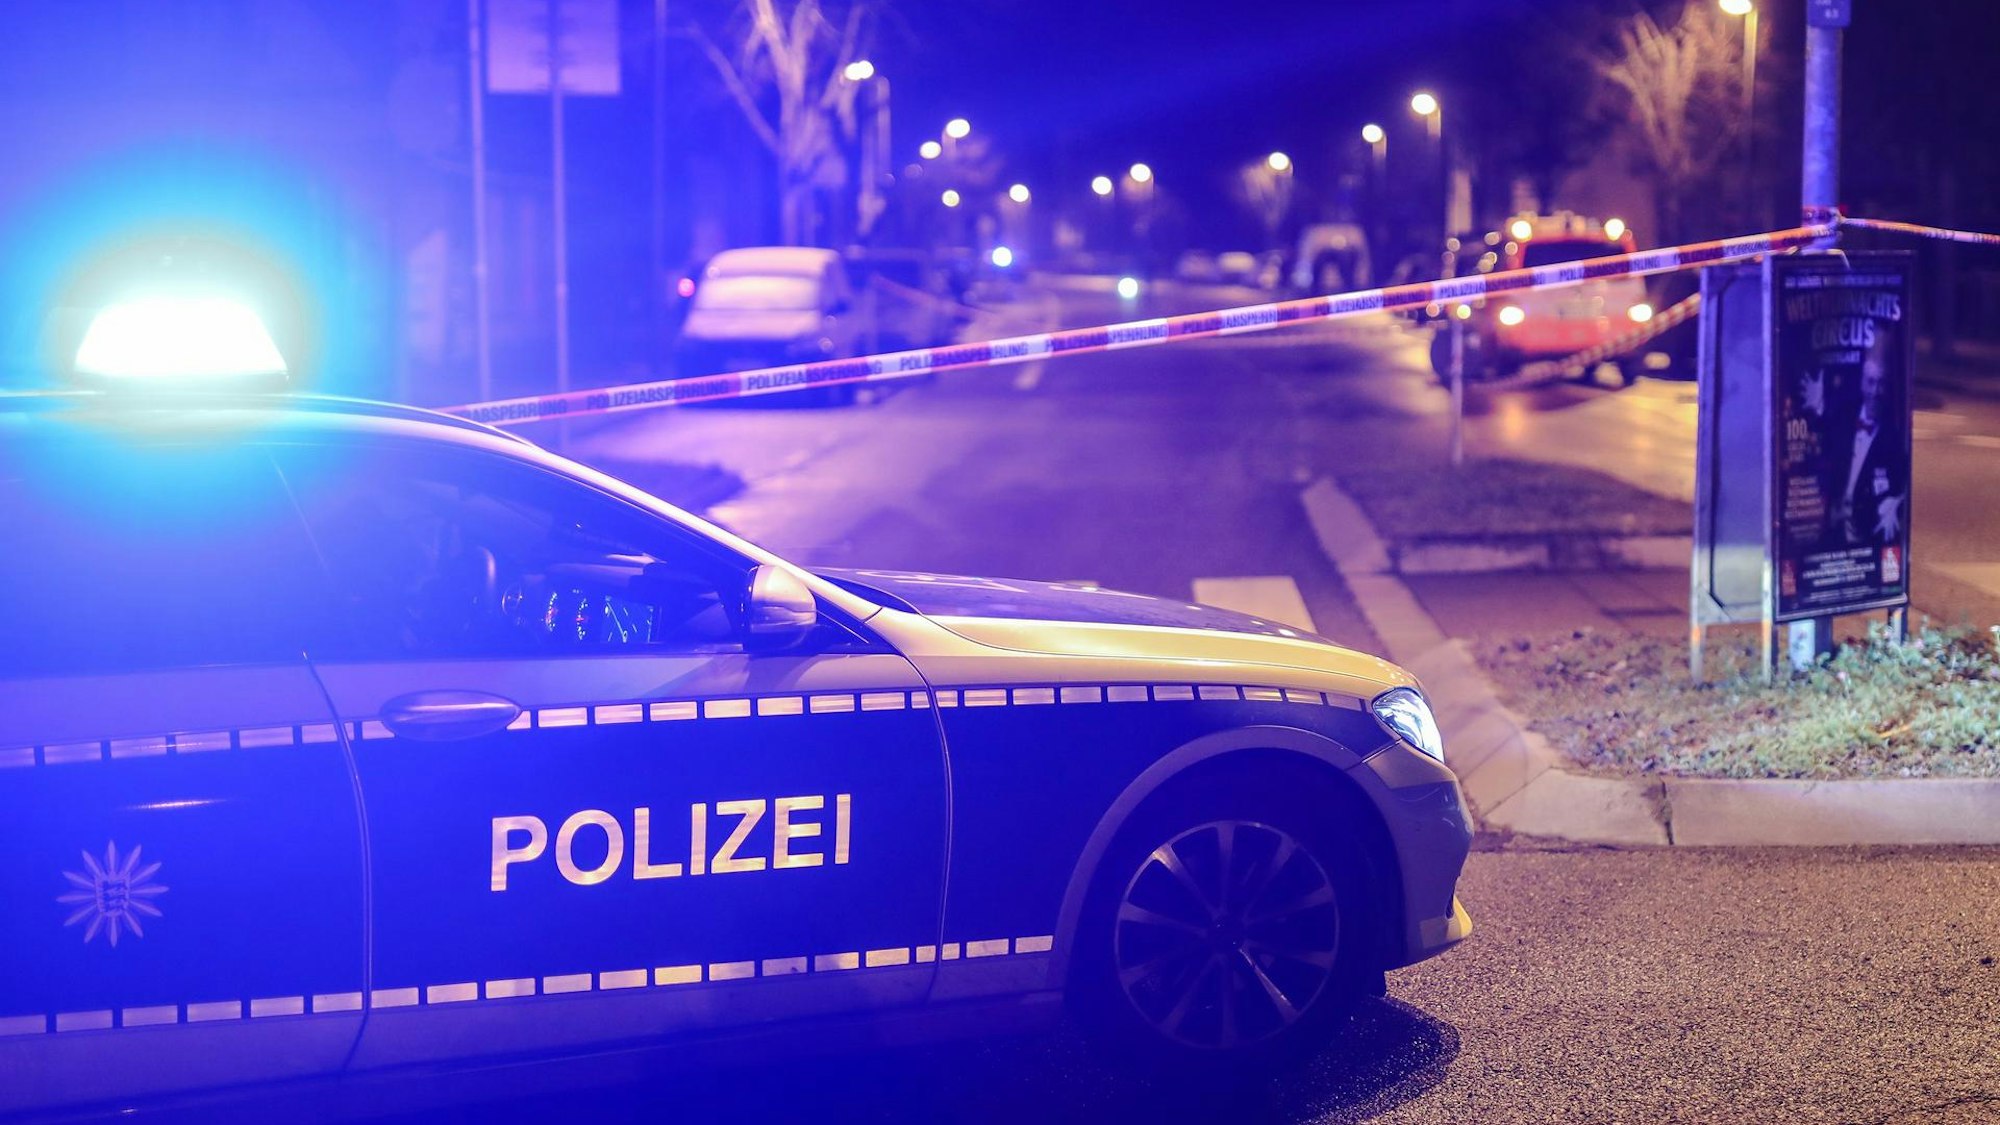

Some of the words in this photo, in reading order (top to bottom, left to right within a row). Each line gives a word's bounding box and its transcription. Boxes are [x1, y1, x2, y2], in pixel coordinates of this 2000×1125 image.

[1811, 317, 1876, 350] CIRCUS
[1786, 418, 1808, 441] 100
[491, 794, 851, 891] POLIZEI
